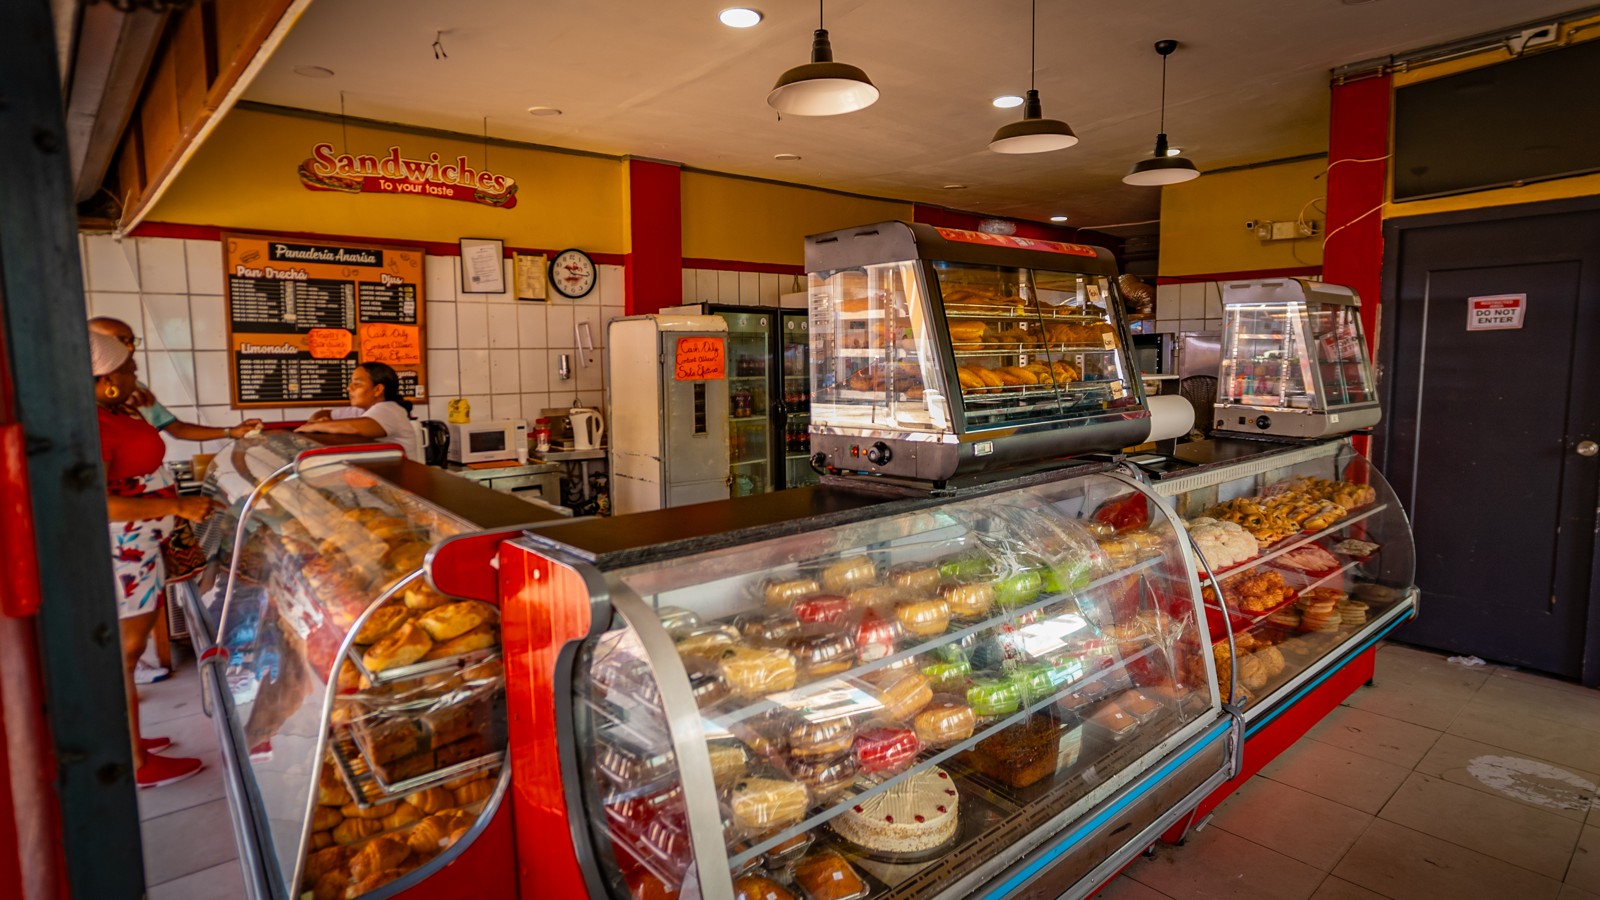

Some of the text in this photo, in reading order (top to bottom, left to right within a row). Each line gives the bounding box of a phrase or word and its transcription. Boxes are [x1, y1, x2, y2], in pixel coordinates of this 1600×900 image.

[313, 143, 507, 193] Sandwiches
[379, 179, 454, 197] To your taste
[335, 248, 376, 263] Anarisa
[237, 266, 262, 278] Pan
[381, 273, 403, 286] Djus
[366, 324, 387, 338] Cash
[241, 343, 298, 354] Limonada
[681, 339, 718, 357] Cash Only
